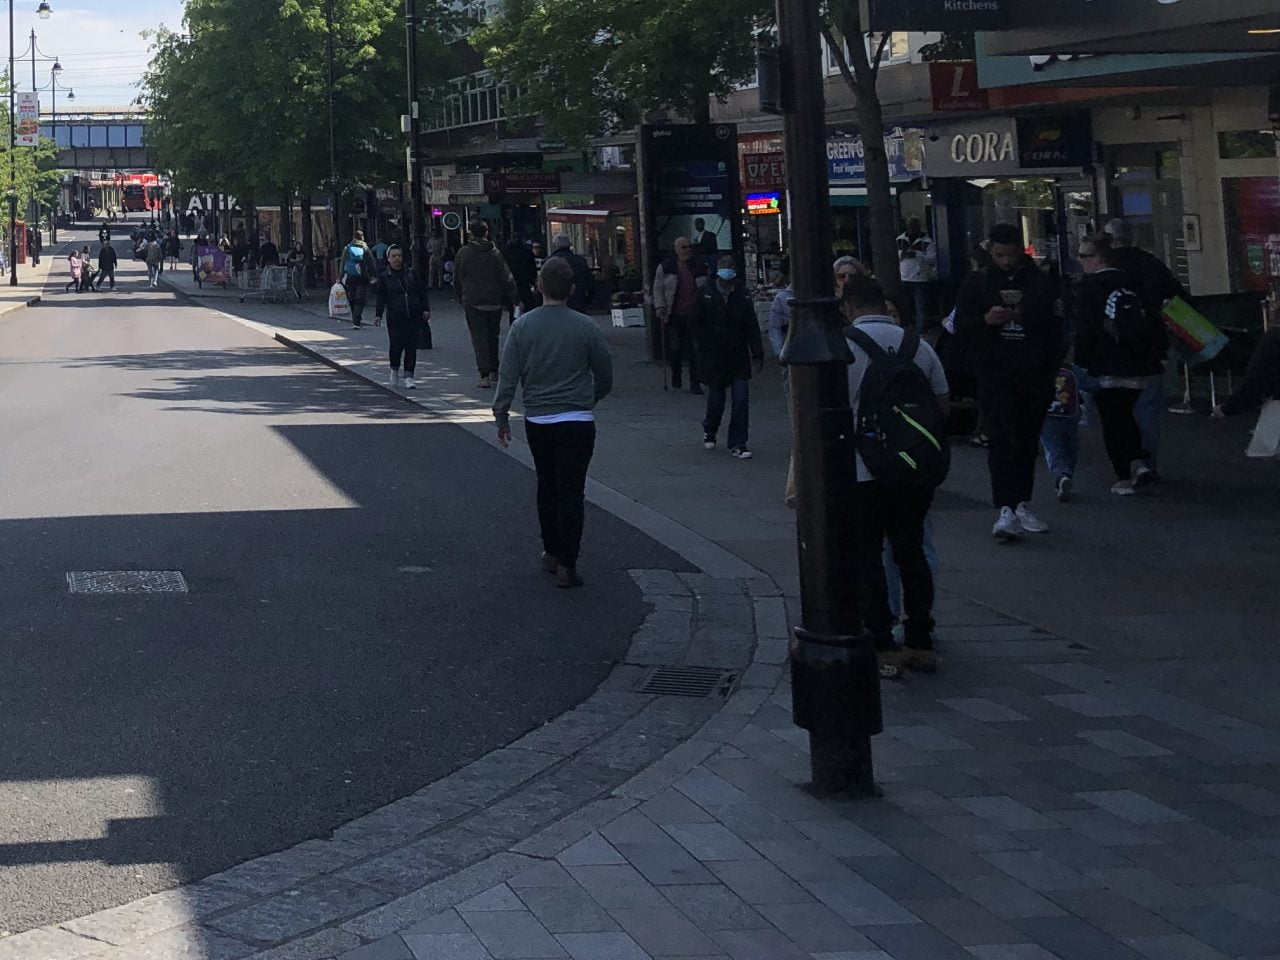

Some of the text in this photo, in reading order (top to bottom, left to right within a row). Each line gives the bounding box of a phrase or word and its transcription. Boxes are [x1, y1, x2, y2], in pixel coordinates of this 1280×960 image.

[944, 0, 998, 11] Kitchens
[826, 140, 855, 160] GREEN
[951, 132, 1015, 163] CORA
